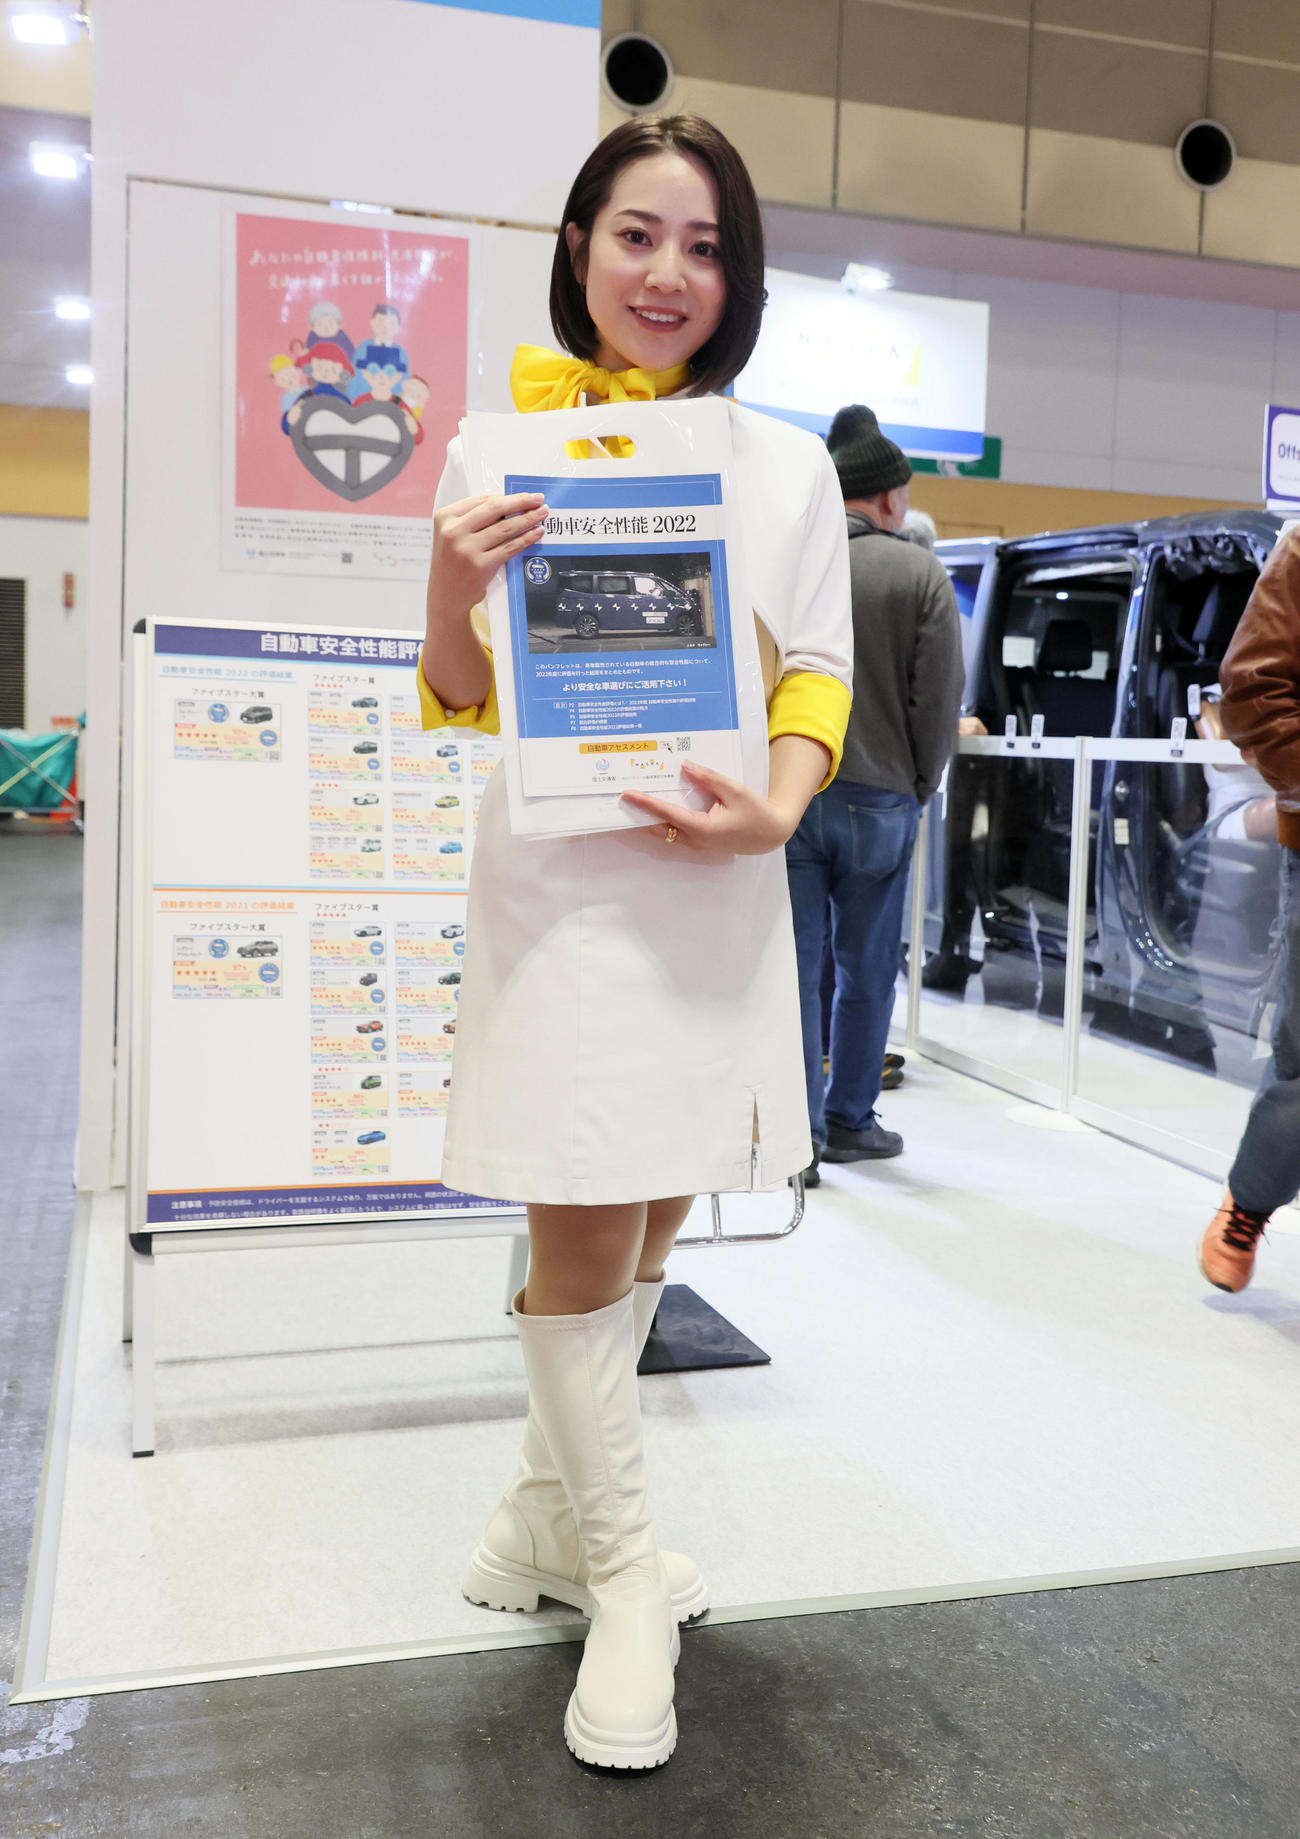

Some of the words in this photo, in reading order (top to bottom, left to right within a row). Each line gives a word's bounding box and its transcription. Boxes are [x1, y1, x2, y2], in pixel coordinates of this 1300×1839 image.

[543, 516, 649, 535] 動車安全性能
[653, 514, 697, 533] 2022
[587, 743, 649, 752] 自動車アセスメント
